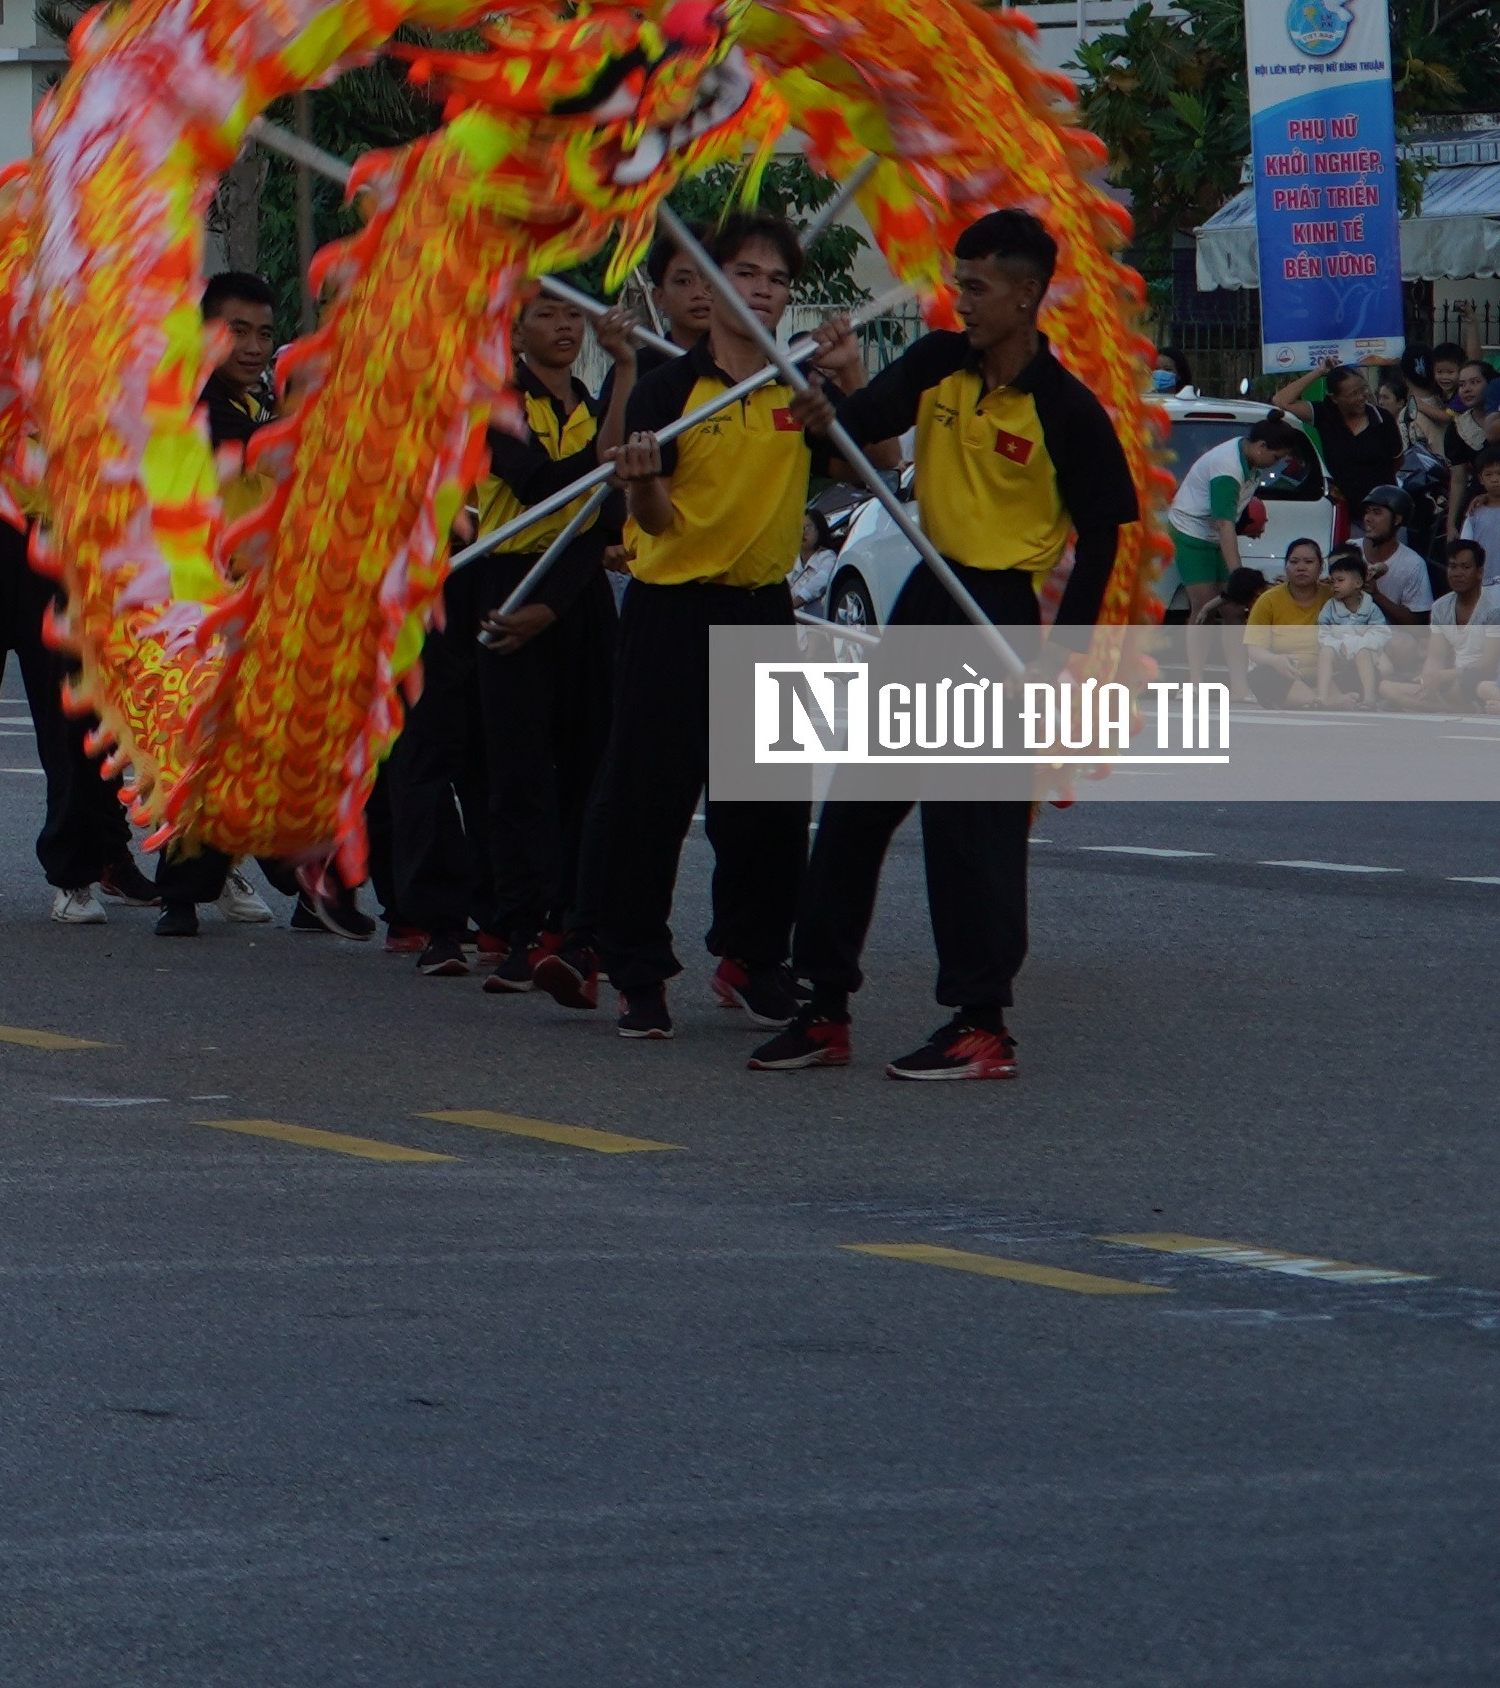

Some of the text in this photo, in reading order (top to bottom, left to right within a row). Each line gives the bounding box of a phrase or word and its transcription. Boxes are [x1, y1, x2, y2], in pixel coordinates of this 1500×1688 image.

[1288, 112, 1359, 144] PHỤ NỮ
[1264, 147, 1310, 177] KHỞI
[1273, 173, 1380, 211] PHÁT TRIỂN
[1292, 213, 1366, 244] KINH TẾ
[1283, 249, 1377, 280] BỀN VỮNG
